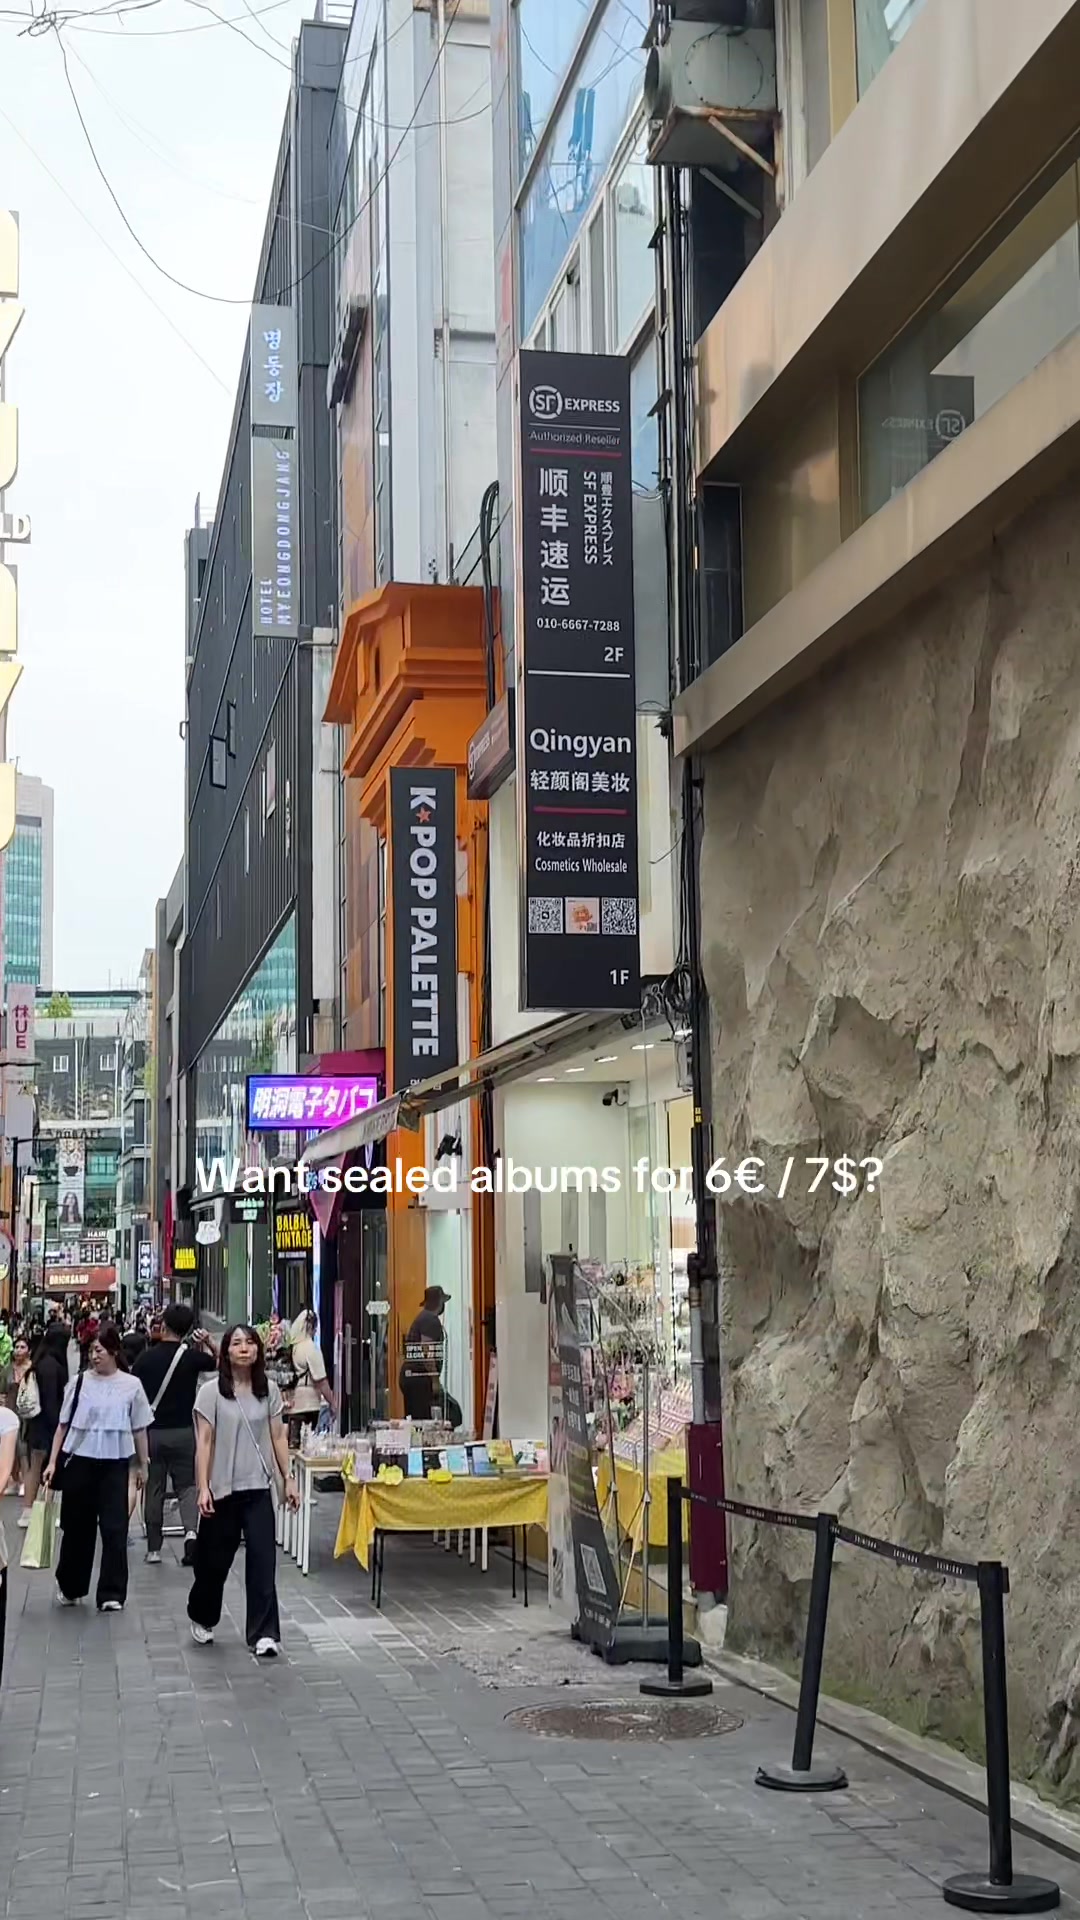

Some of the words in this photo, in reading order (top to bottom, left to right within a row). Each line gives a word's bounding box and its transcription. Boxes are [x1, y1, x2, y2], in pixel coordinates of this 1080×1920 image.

[264, 328, 284, 404] 명동장
[564, 397, 621, 414] EXPRESS
[530, 430, 583, 446] Authorized
[584, 433, 621, 447] Reseller
[582, 471, 597, 491] SF
[539, 467, 571, 606] 顺丰速运
[582, 494, 598, 566] EXPRESS
[260, 578, 273, 624] HOTEL
[536, 617, 621, 632] 010-6667-7288
[604, 646, 625, 662] 2F
[529, 727, 632, 759] Qingyan
[530, 769, 631, 793] 轻颜阁美妆
[536, 831, 626, 849] 化妆品折扣店
[534, 857, 580, 873] Cosmetics
[582, 858, 628, 873] Wholesale
[410, 907, 440, 1057] PALETTE
[609, 969, 630, 985] 1F
[276, 1213, 310, 1231] BALBAL
[275, 1230, 313, 1249] VINTAGE
